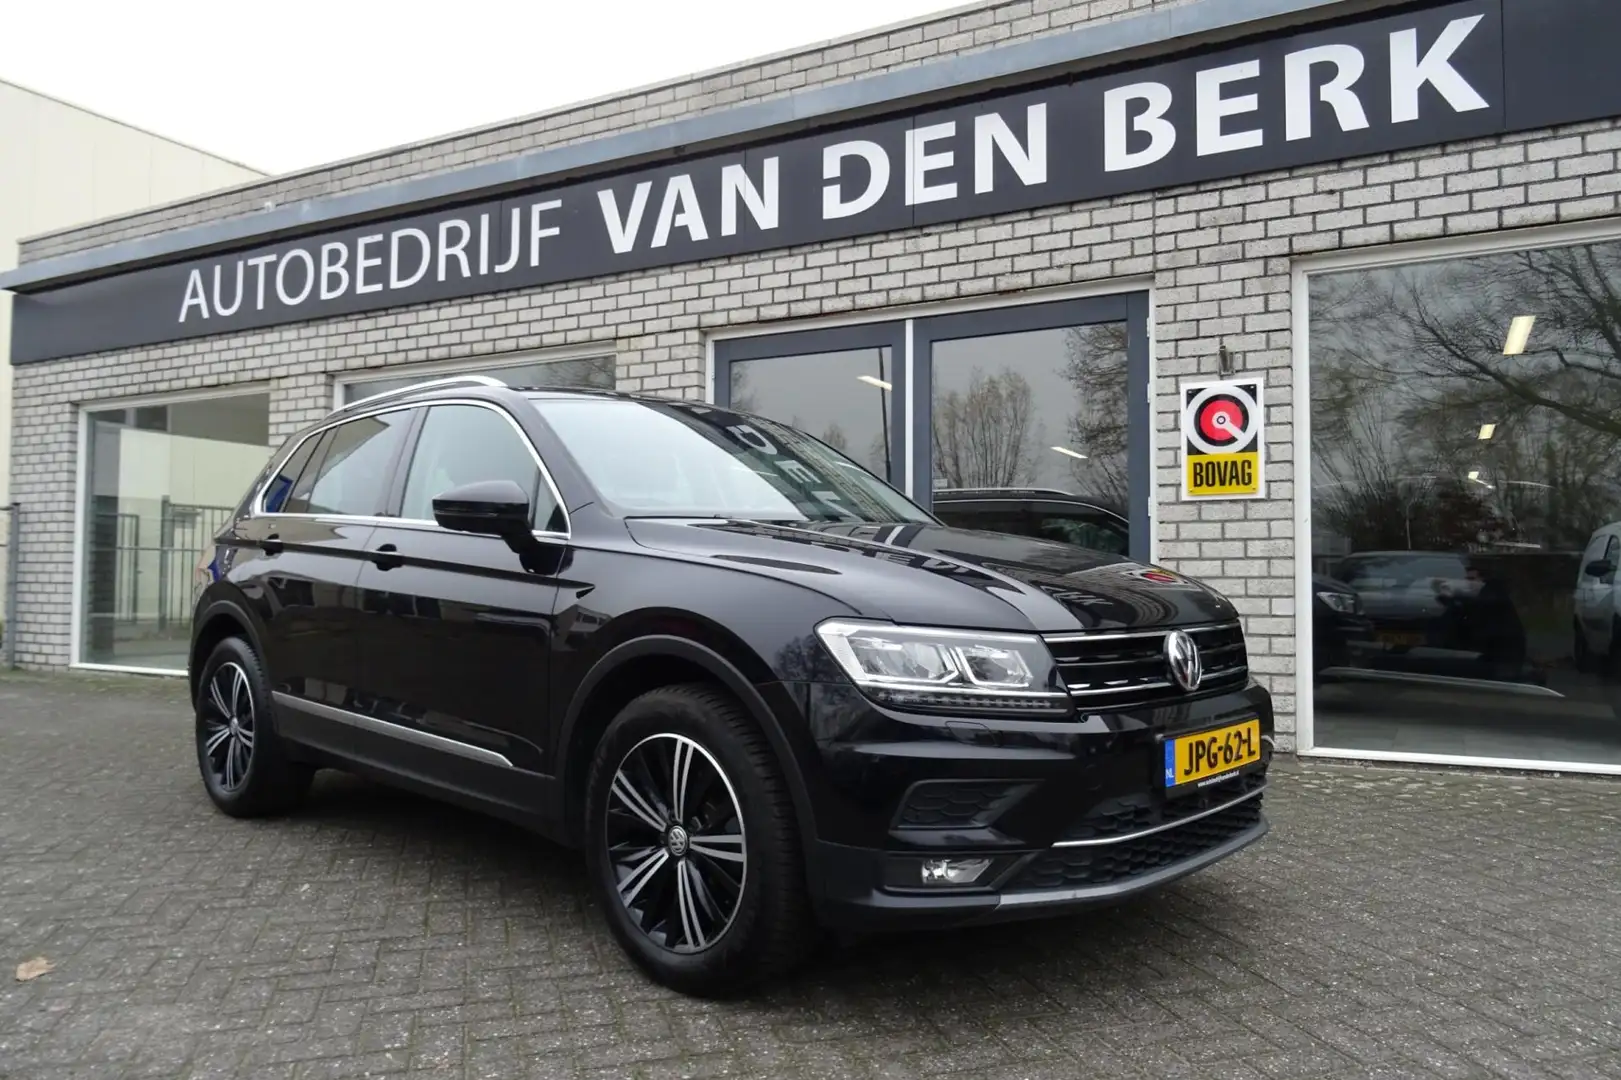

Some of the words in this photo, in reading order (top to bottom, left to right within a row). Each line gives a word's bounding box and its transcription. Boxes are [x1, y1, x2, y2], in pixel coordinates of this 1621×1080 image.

[179, 199, 562, 323] AUTOBEDRIJF
[597, 156, 779, 254] VAN
[822, 102, 1047, 220] DEN
[1103, 13, 1490, 172] BERK
[1193, 459, 1252, 488] BOVAG
[1183, 727, 1256, 776] JPG-62-L
